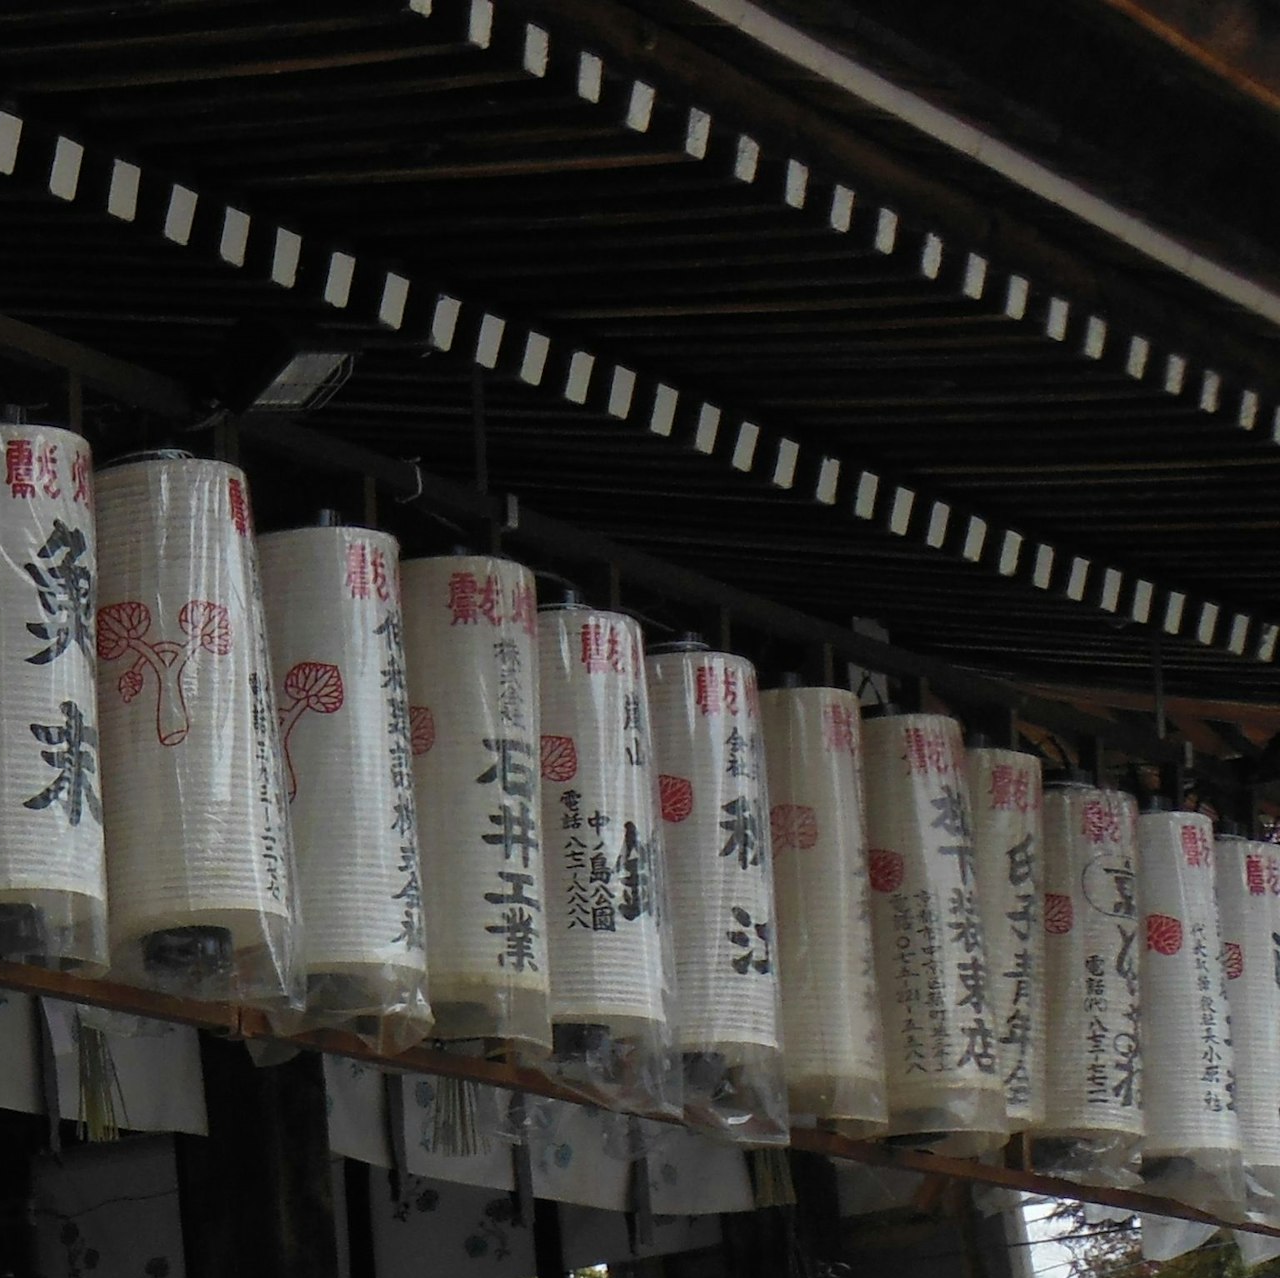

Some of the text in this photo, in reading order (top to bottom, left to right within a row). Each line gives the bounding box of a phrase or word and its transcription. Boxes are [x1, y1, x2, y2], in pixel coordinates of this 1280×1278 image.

[467, 737, 541, 973] 石井工業
[587, 810, 617, 933] 中ノ島公園
